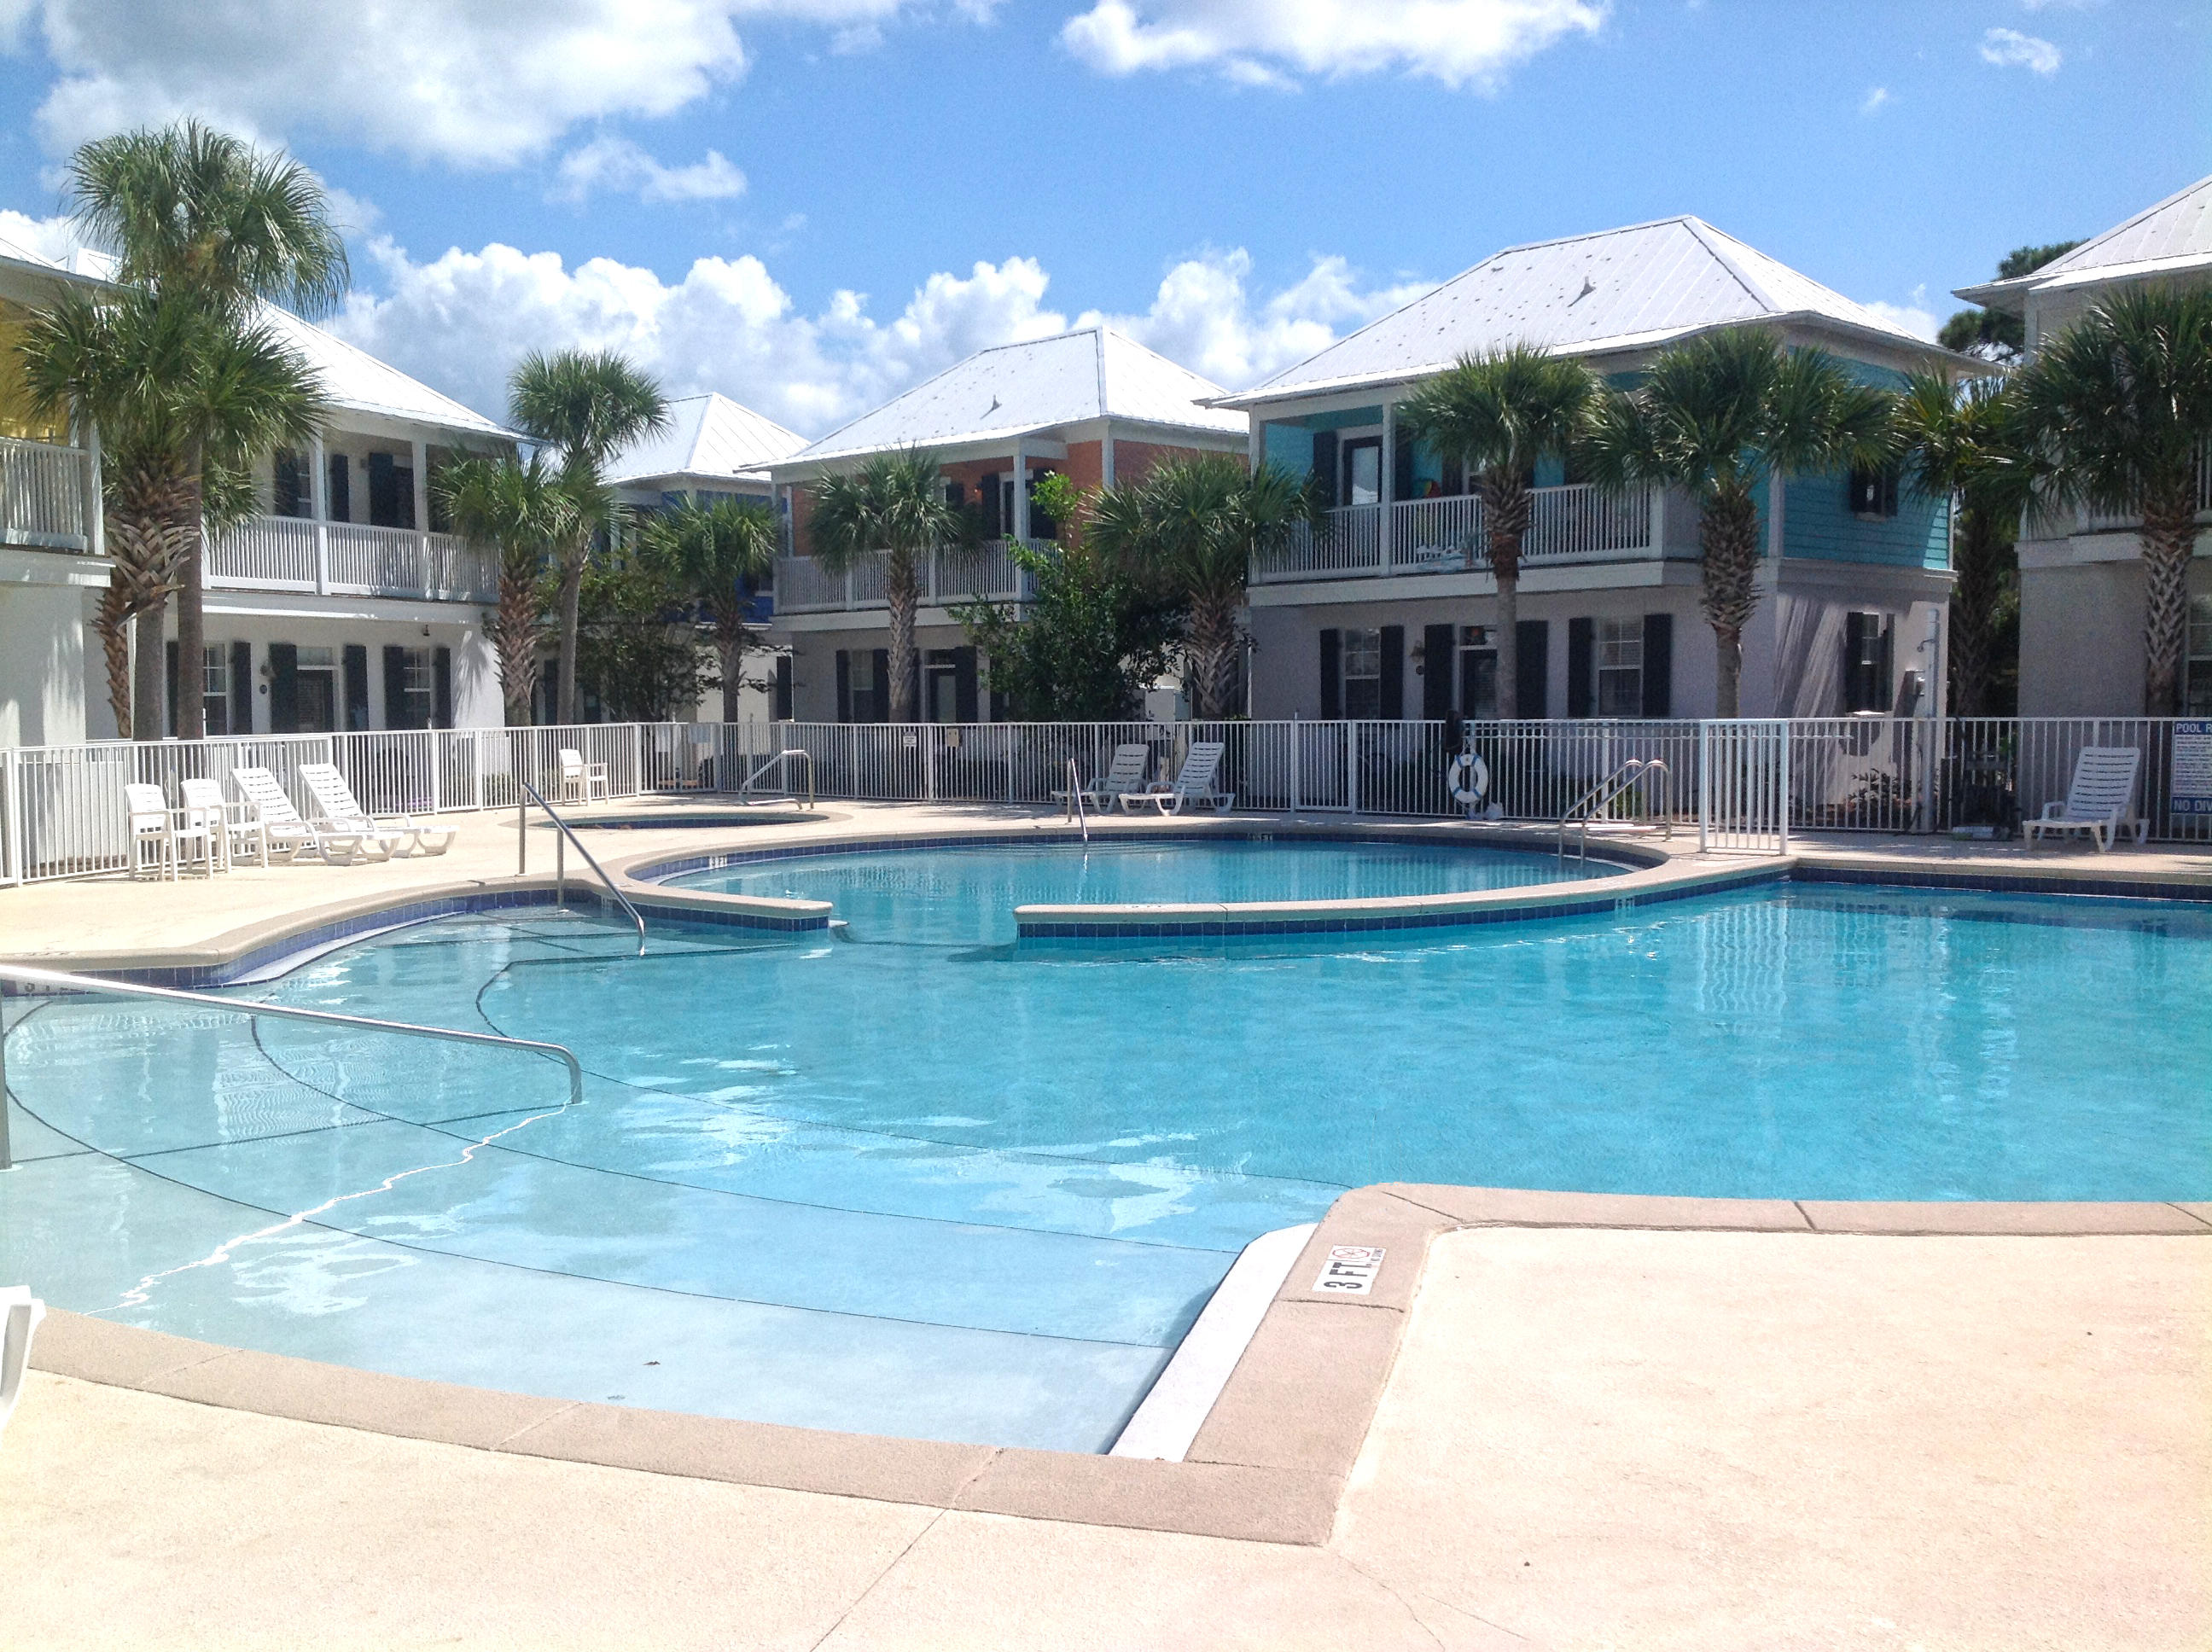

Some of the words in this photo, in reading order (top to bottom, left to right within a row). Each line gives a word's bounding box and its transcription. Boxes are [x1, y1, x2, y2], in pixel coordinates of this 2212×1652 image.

[2176, 723, 2202, 733] POOL
[2174, 800, 2191, 811] NO
[1323, 1281, 1363, 1289] 3
